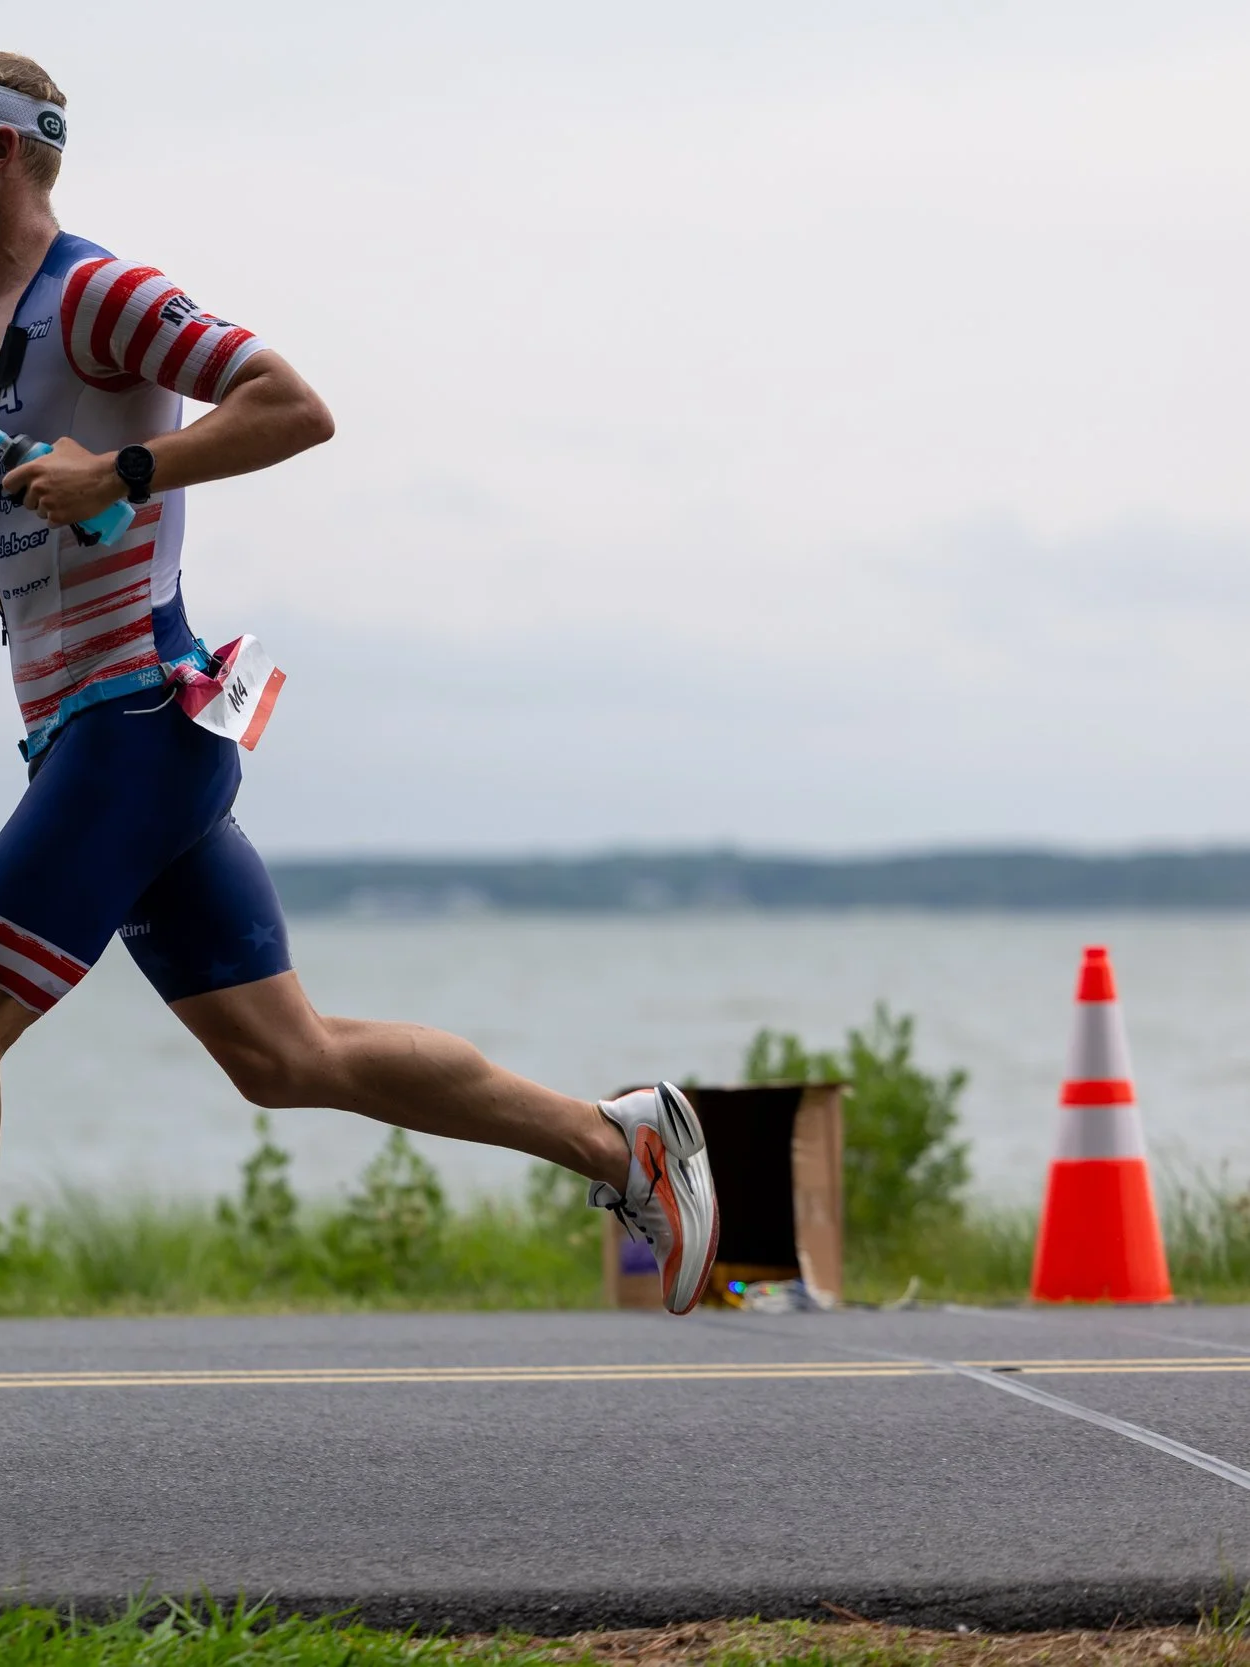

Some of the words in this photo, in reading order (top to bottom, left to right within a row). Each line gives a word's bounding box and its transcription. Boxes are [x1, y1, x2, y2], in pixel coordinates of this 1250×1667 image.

[25, 316, 53, 340] tini
[12, 575, 51, 597] RUDY
[228, 676, 249, 714] M4
